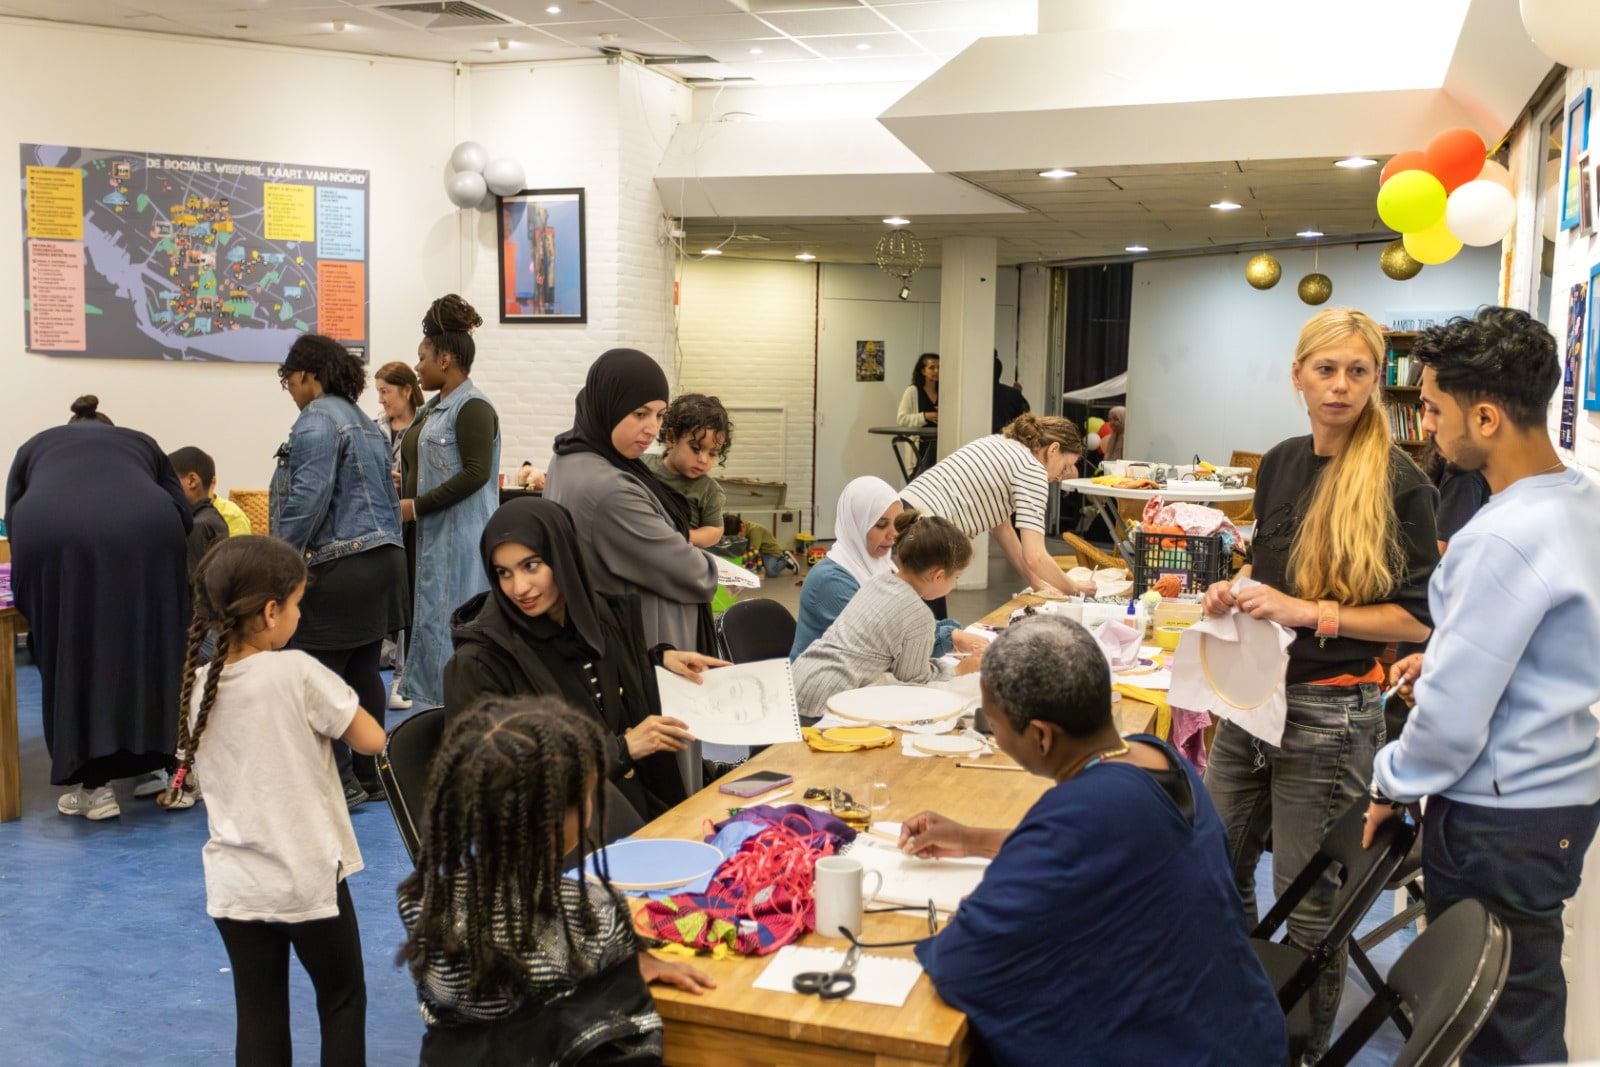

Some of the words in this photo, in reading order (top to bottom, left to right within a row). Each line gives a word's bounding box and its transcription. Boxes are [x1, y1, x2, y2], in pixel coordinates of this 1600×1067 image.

[146, 158, 161, 169] DE
[164, 159, 212, 173] SOCIALE
[214, 163, 265, 176] WEEFSEL
[267, 167, 303, 179] KAART
[306, 170, 328, 181] VAN
[330, 172, 366, 185] NOORD
